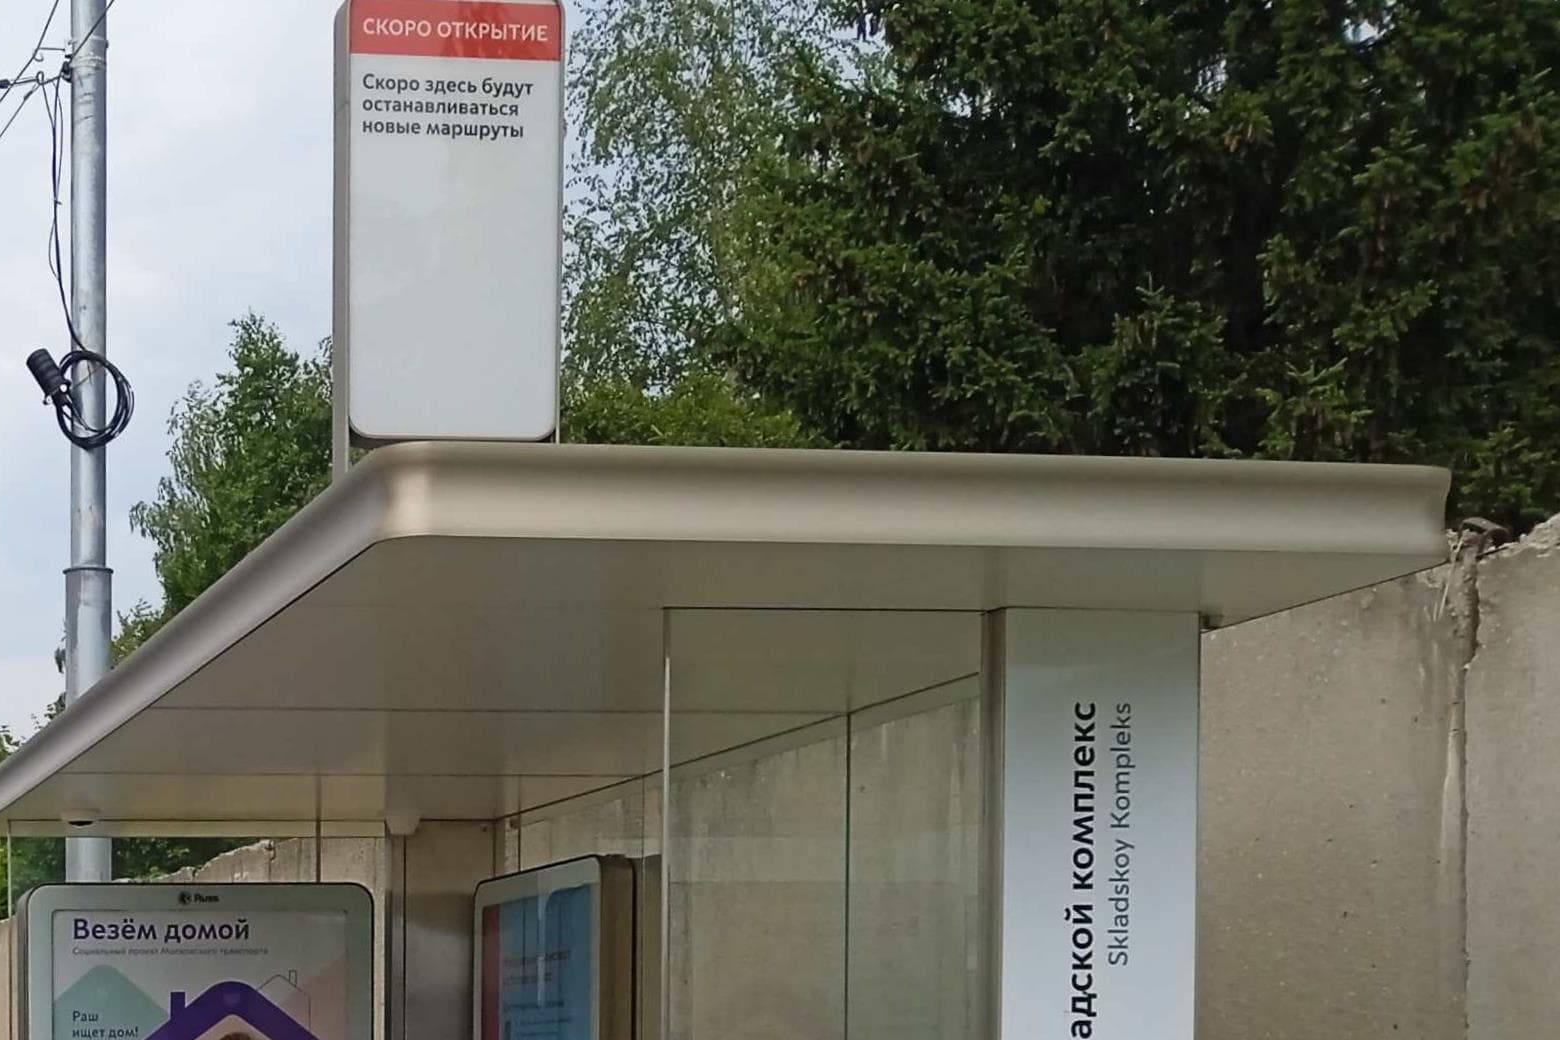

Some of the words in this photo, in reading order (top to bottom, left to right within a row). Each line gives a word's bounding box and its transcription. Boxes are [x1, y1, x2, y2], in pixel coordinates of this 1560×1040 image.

[362, 17, 432, 37] СКОРО
[436, 20, 548, 42] ОТКРЫТИЕ
[362, 73, 420, 94] Скоро
[425, 80, 477, 93] здесь
[481, 77, 533, 98] будут
[362, 98, 519, 116] останавливаться
[362, 120, 421, 135] новые
[426, 124, 524, 141] маршруты
[1109, 701, 1136, 828] Kompleks
[1071, 701, 1097, 890] комплекс
[1107, 838, 1136, 966] Skladskoy
[73, 918, 157, 940] Везём
[164, 919, 250, 943] домой
[72, 1010, 99, 1021] Раш
[72, 1028, 105, 1039] ищет
[109, 1026, 139, 1039] дом!
